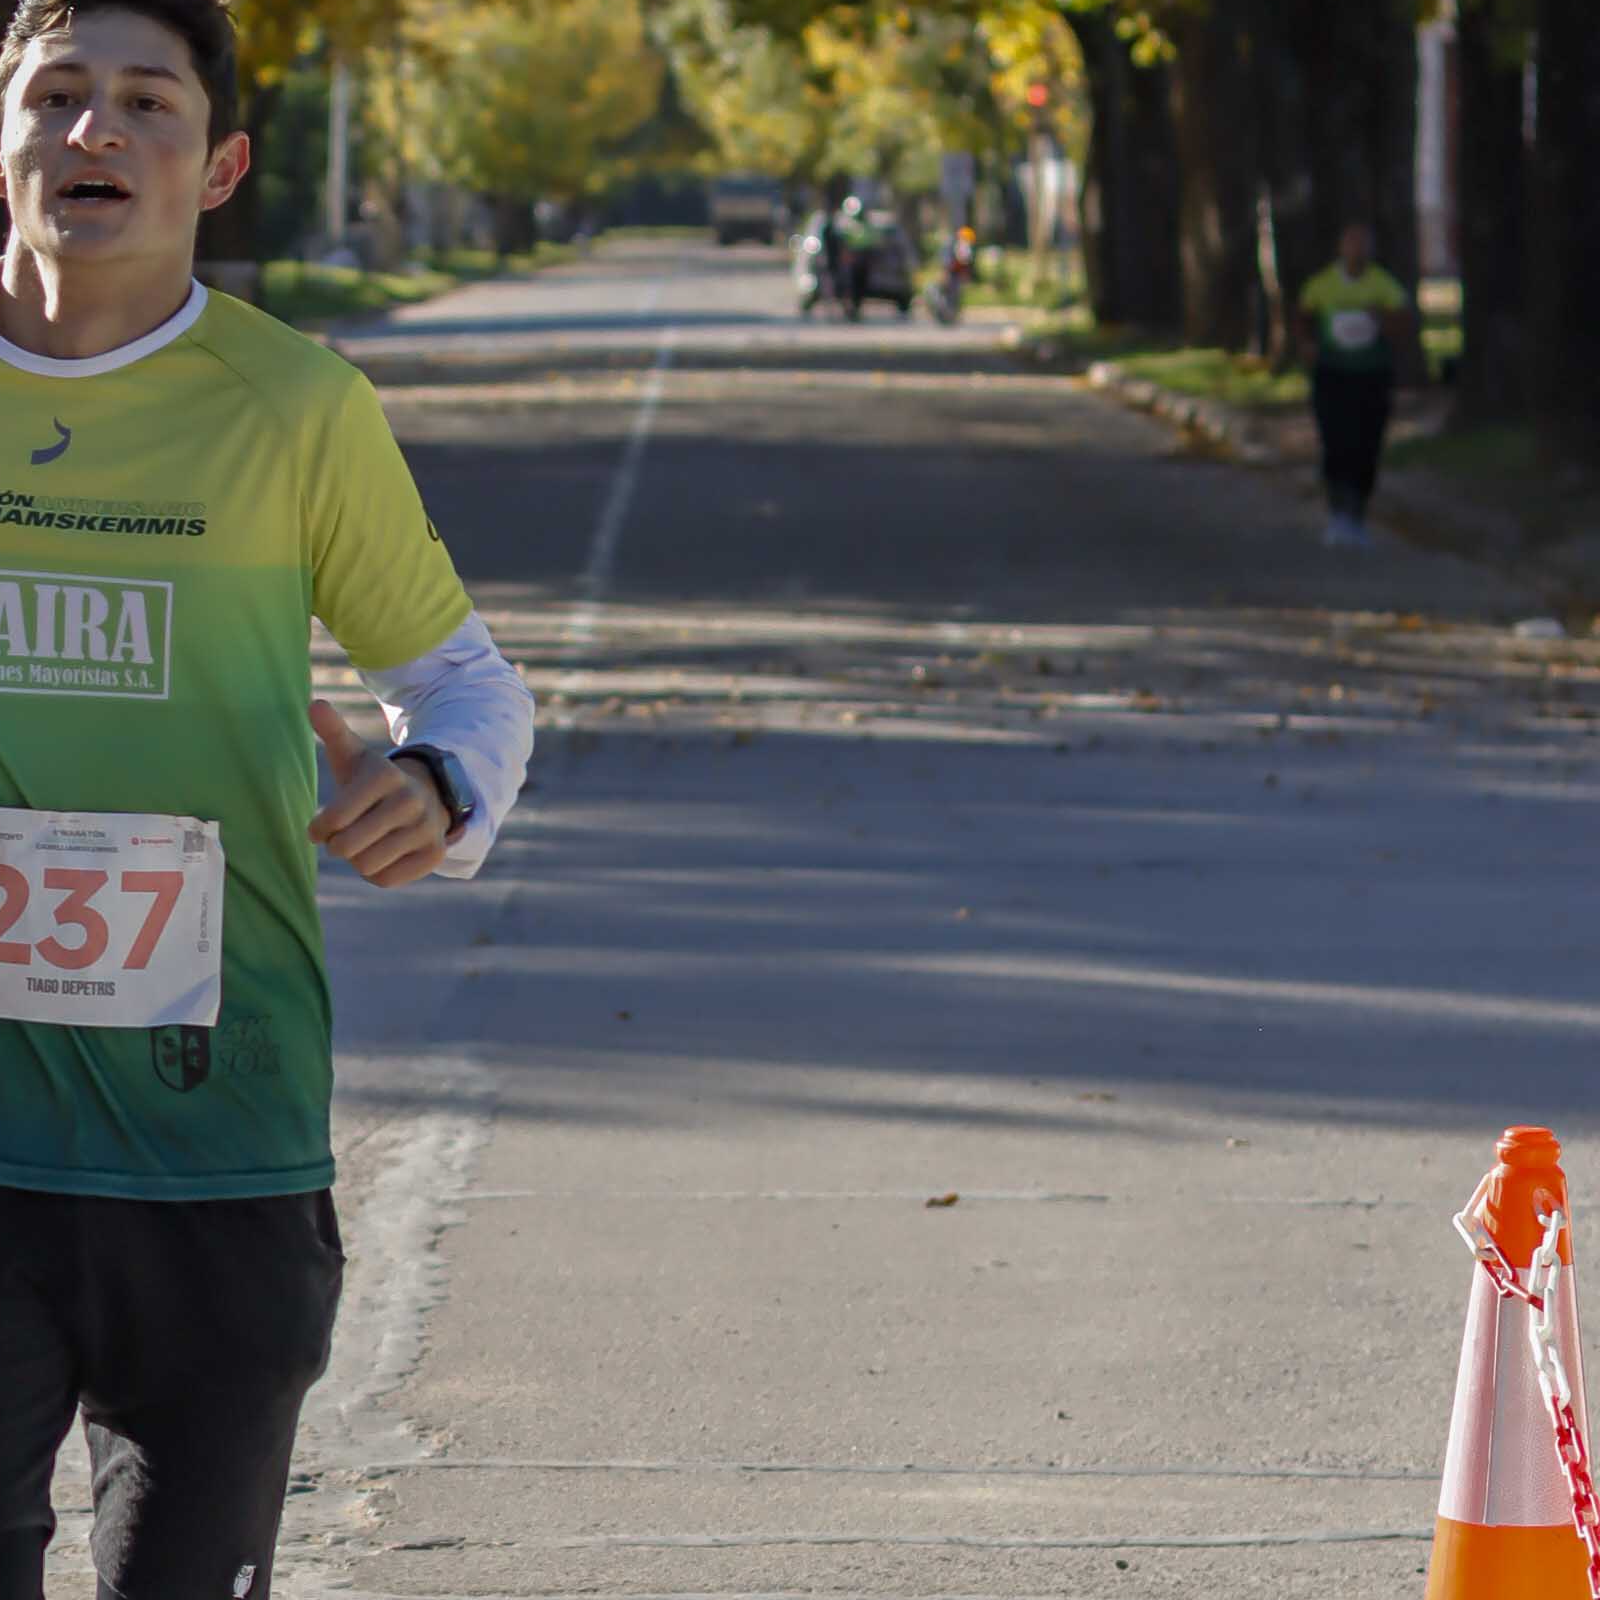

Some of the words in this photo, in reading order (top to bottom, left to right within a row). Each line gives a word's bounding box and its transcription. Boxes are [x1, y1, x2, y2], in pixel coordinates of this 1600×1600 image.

[29, 663, 120, 687] Mayoristas
[124, 669, 156, 689] S.A.
[26, 977, 60, 994] TIAGO
[61, 979, 116, 996] DEPETRIS
